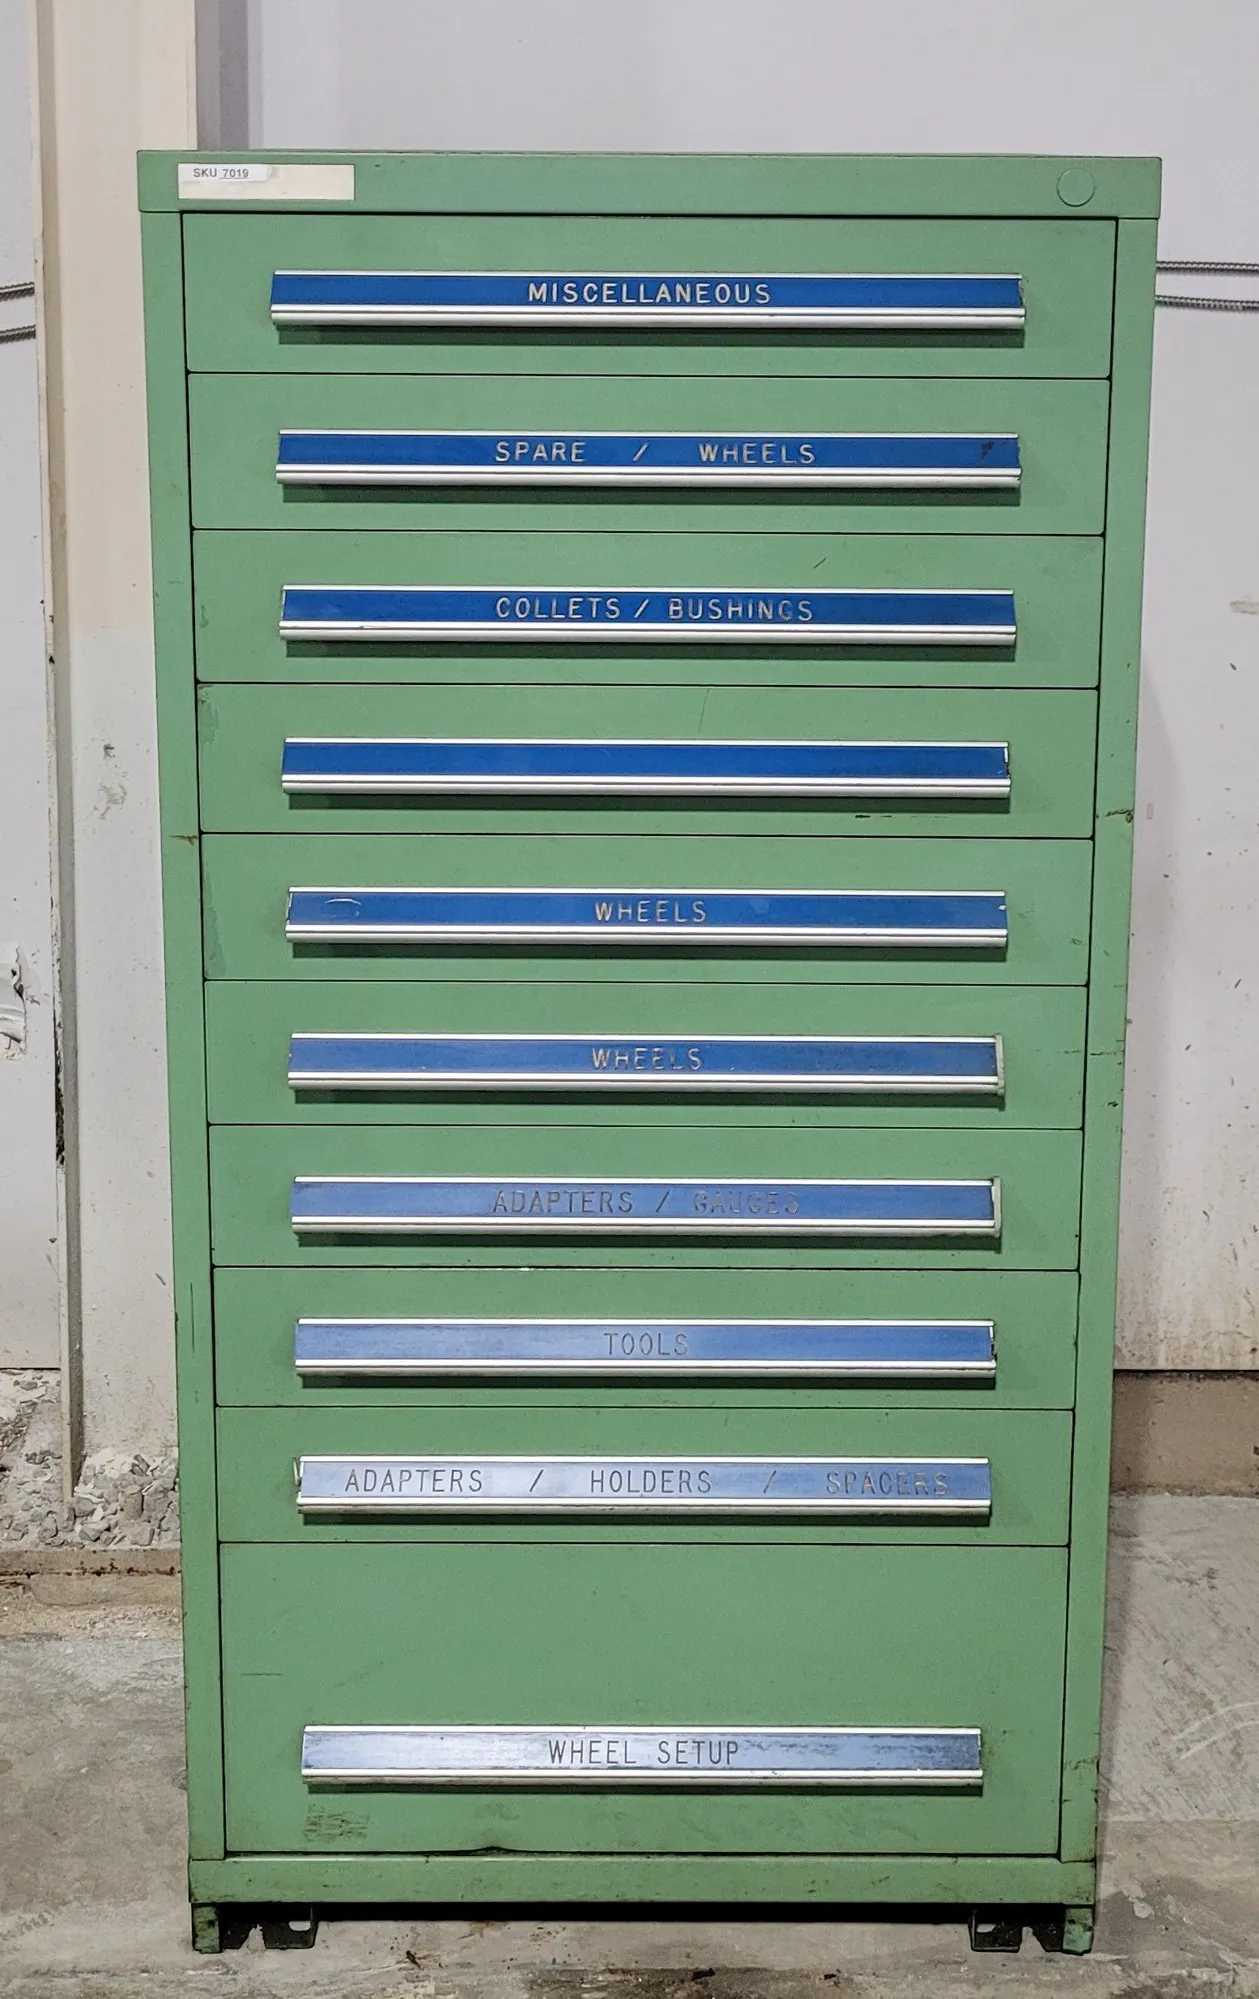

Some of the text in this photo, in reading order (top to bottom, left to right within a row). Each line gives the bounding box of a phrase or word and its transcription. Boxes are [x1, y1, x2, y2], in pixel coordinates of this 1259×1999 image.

[193, 168, 249, 178] SKU 7019
[527, 282, 772, 304] MISCELLANEOUS
[494, 441, 586, 463] SPARE
[699, 443, 816, 464] WHEELS
[495, 596, 621, 620] COLLETS
[594, 899, 707, 923] WHEELS
[591, 1046, 703, 1071] WHEELS
[492, 1190, 633, 1214] ADAPTERS
[603, 1331, 689, 1357] TOOLS
[345, 1468, 483, 1493] ADAPTERS
[590, 1468, 713, 1494] HOLDERS
[825, 1470, 950, 1496] SPACERS
[548, 1739, 739, 1765] WHEEL SETUP
